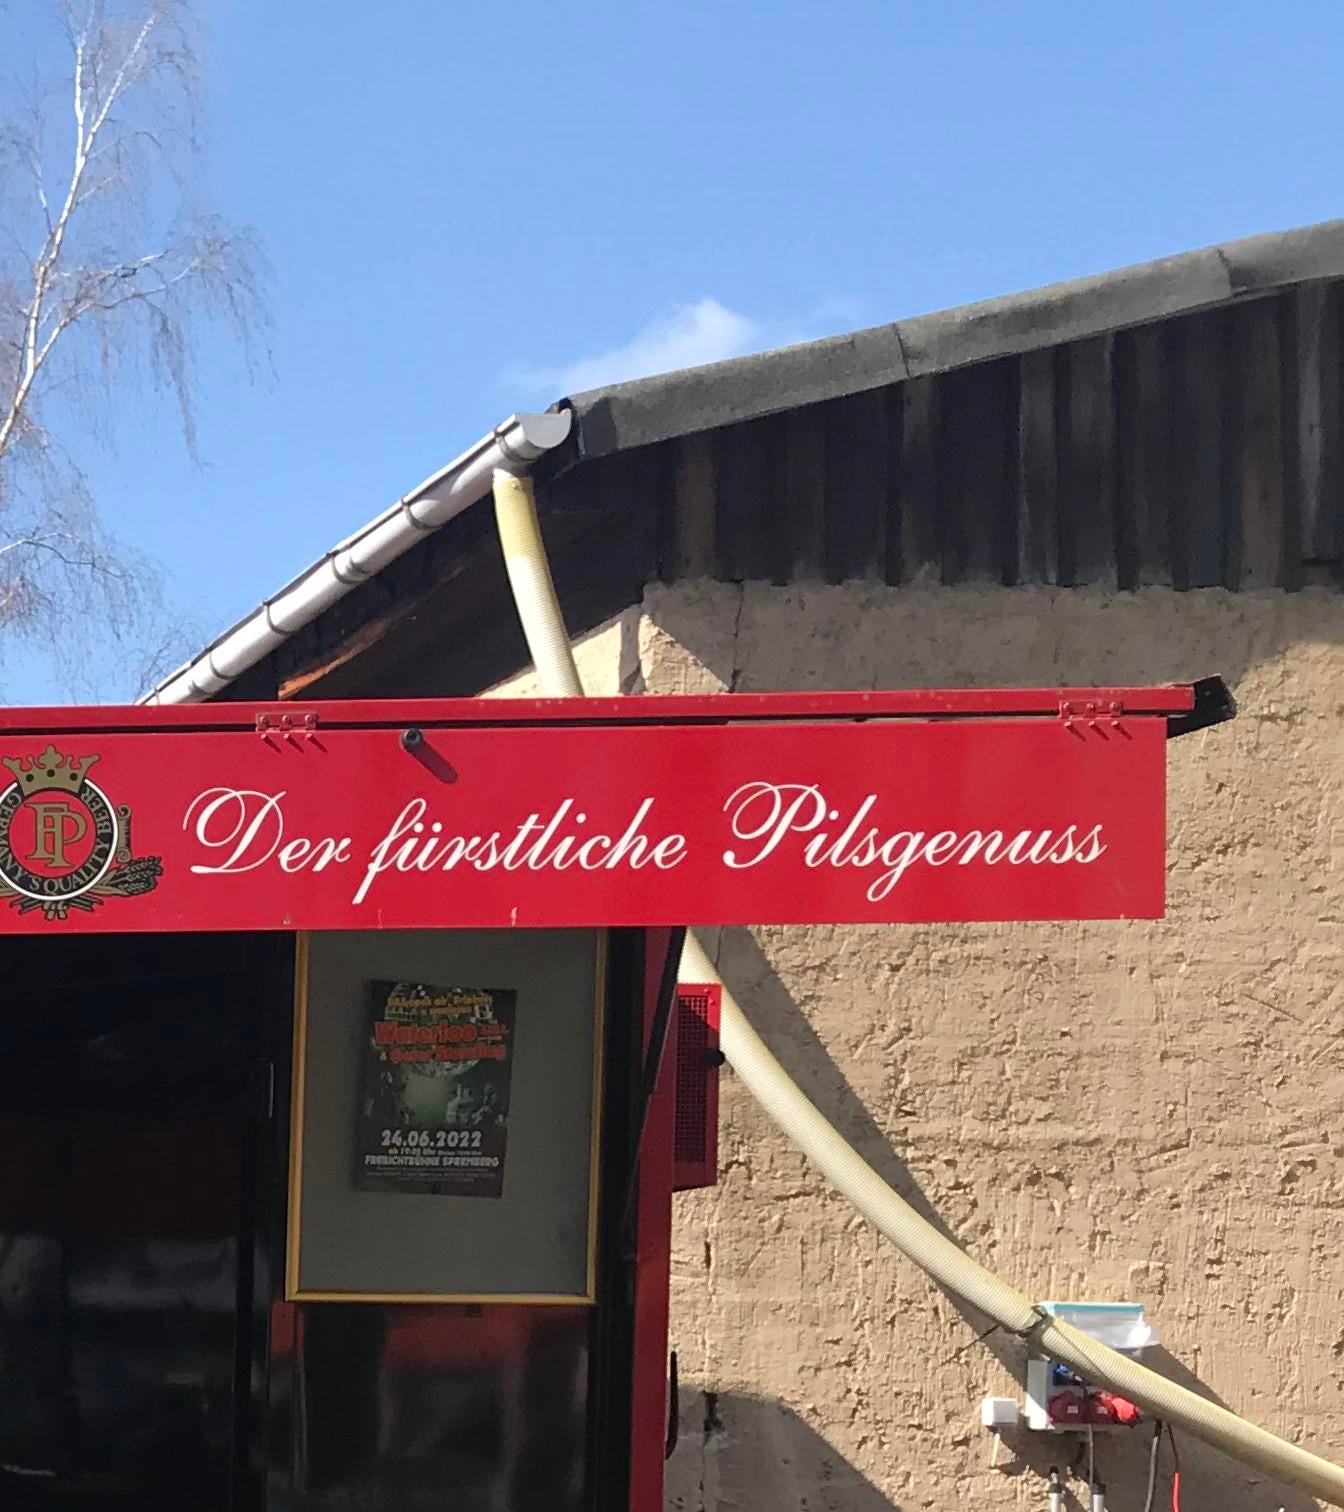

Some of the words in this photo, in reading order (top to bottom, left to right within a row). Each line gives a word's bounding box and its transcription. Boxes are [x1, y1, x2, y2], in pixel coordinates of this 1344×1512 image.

[43, 839, 110, 895] QUALITY
[80, 787, 112, 834] BEER
[182, 785, 352, 876] Der
[350, 796, 688, 906] fürstliche
[722, 781, 1108, 903] Pilsgenuss
[381, 1129, 482, 1148] 24.06.2022
